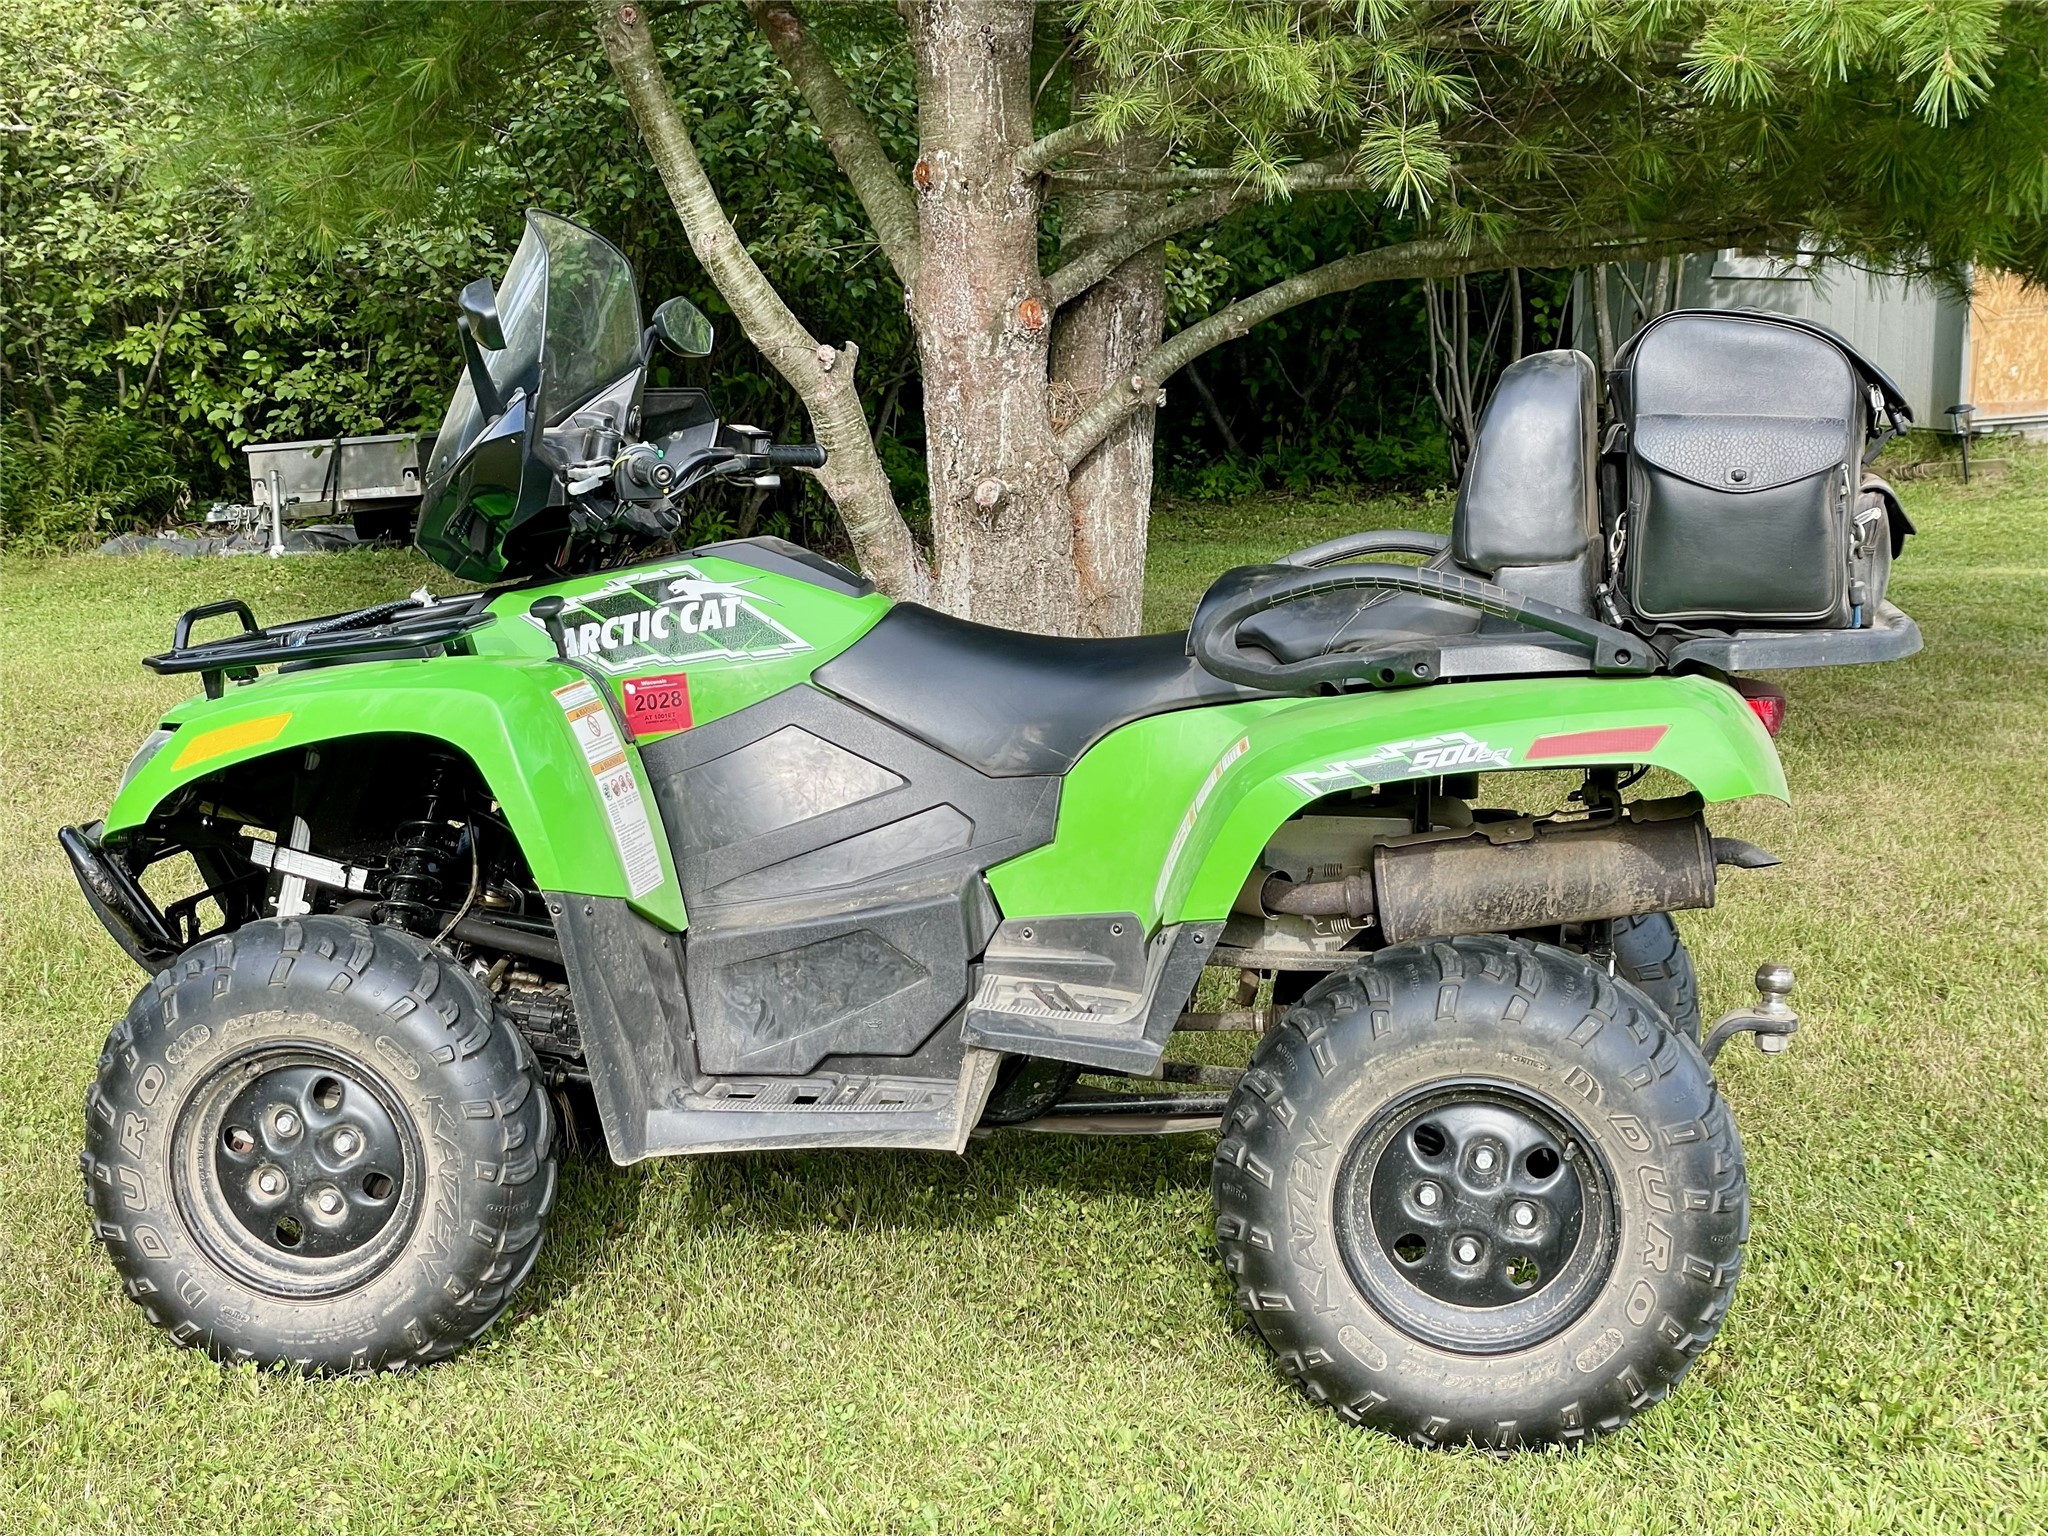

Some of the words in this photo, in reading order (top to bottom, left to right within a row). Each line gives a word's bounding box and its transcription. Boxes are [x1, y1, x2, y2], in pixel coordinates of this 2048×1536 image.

[563, 606, 670, 658] ARCTIC
[679, 596, 742, 634] CAT
[634, 690, 682, 712] 2028
[1408, 742, 1488, 773] 500
[117, 1063, 172, 1260] DURO
[416, 1095, 466, 1287] KAZEN
[1287, 1115, 1339, 1317] KAZEN
[1606, 1113, 1674, 1328] DURO
